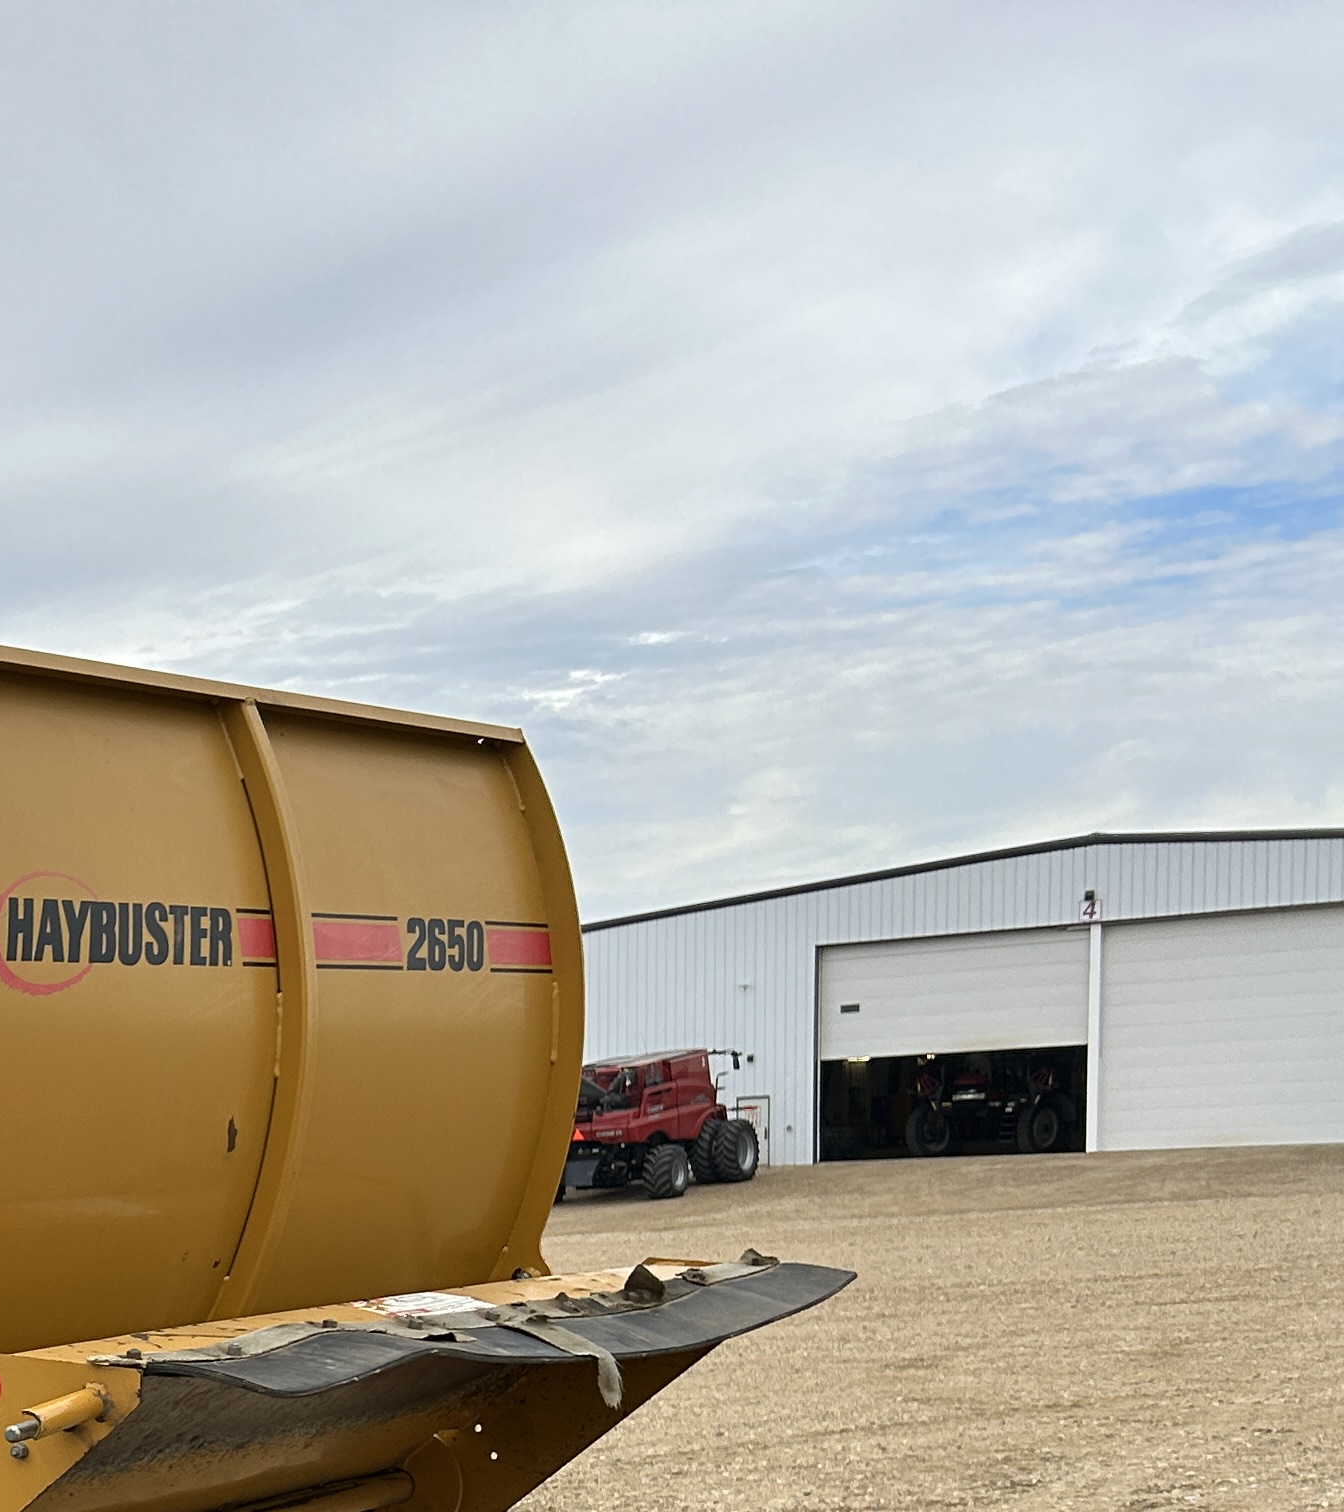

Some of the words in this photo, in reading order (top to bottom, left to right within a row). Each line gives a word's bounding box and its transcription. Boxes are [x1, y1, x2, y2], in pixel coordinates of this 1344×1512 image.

[6, 896, 232, 967] HAYBUSTER
[1083, 900, 1097, 919] 4
[406, 916, 485, 972] 2650
